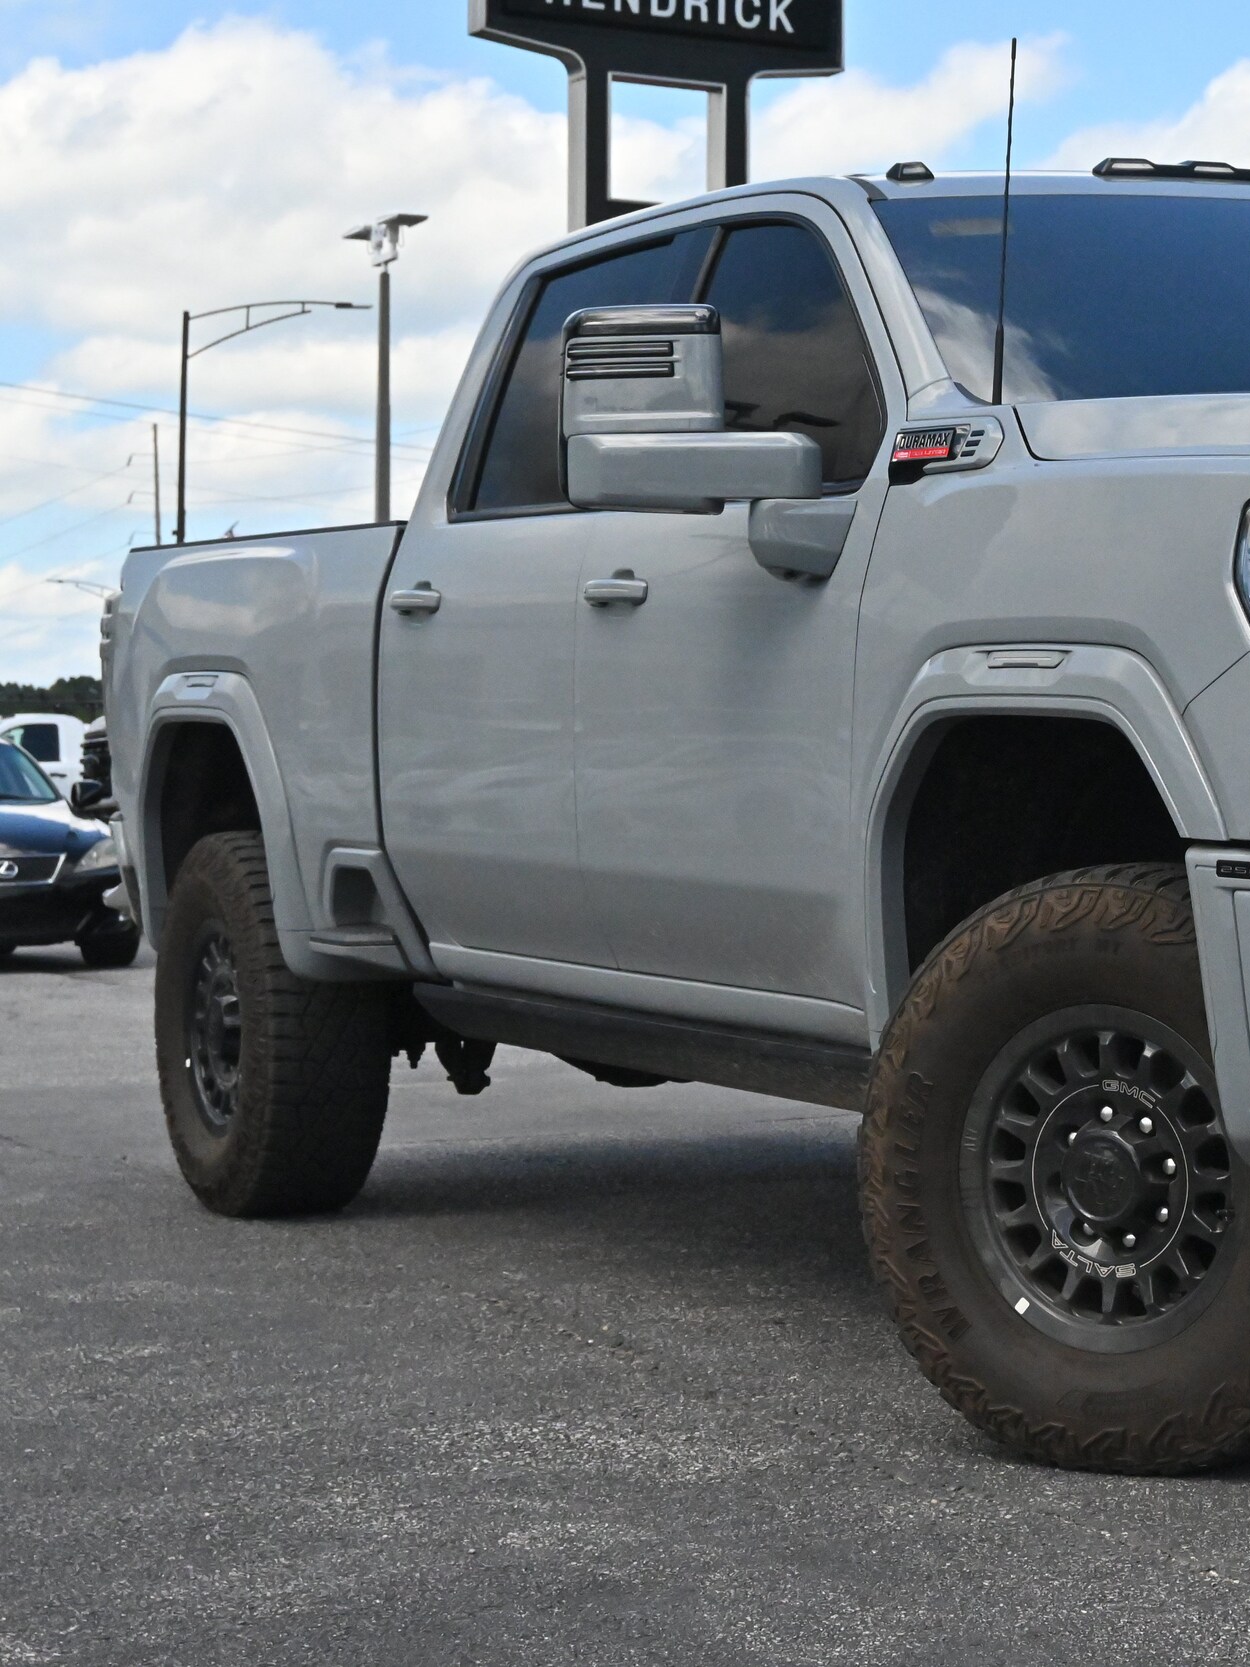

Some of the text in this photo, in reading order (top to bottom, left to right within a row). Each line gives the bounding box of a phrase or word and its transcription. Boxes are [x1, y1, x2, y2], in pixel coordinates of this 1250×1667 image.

[545, 0, 795, 33] DRICK
[899, 433, 950, 449] DURAMAX
[1102, 1080, 1156, 1109] GMC
[893, 1070, 972, 1342] WRANGLER
[1052, 1229, 1136, 1278] SALTA
